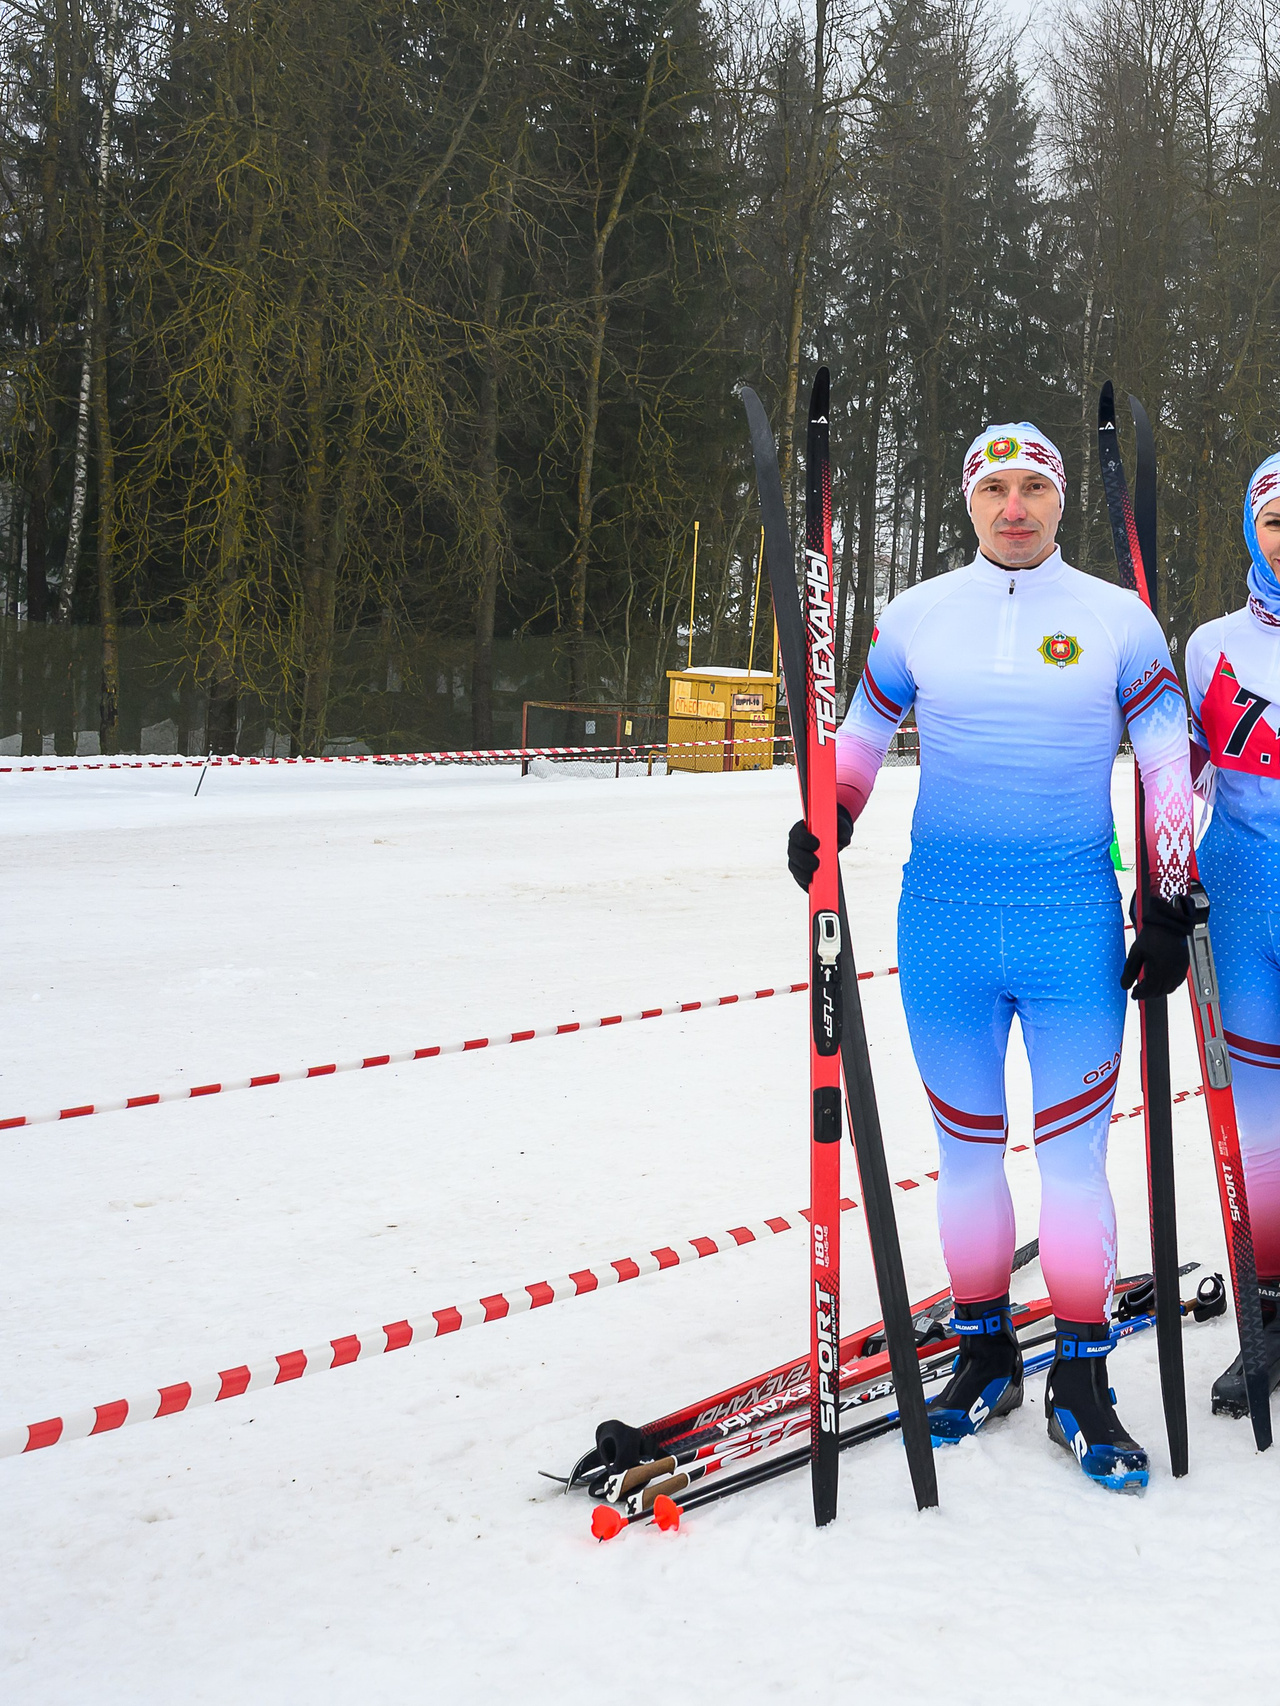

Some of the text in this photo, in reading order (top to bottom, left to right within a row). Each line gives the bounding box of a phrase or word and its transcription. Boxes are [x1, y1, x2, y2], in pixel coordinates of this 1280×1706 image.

[806, 550, 836, 746] ТЕЛЕХАНЫ
[1122, 659, 1161, 698] ORAZ
[1082, 1042, 1122, 1084] ORA
[1222, 1162, 1241, 1222] SPORT
[814, 1223, 825, 1267] 180
[815, 1280, 836, 1435] SPORT
